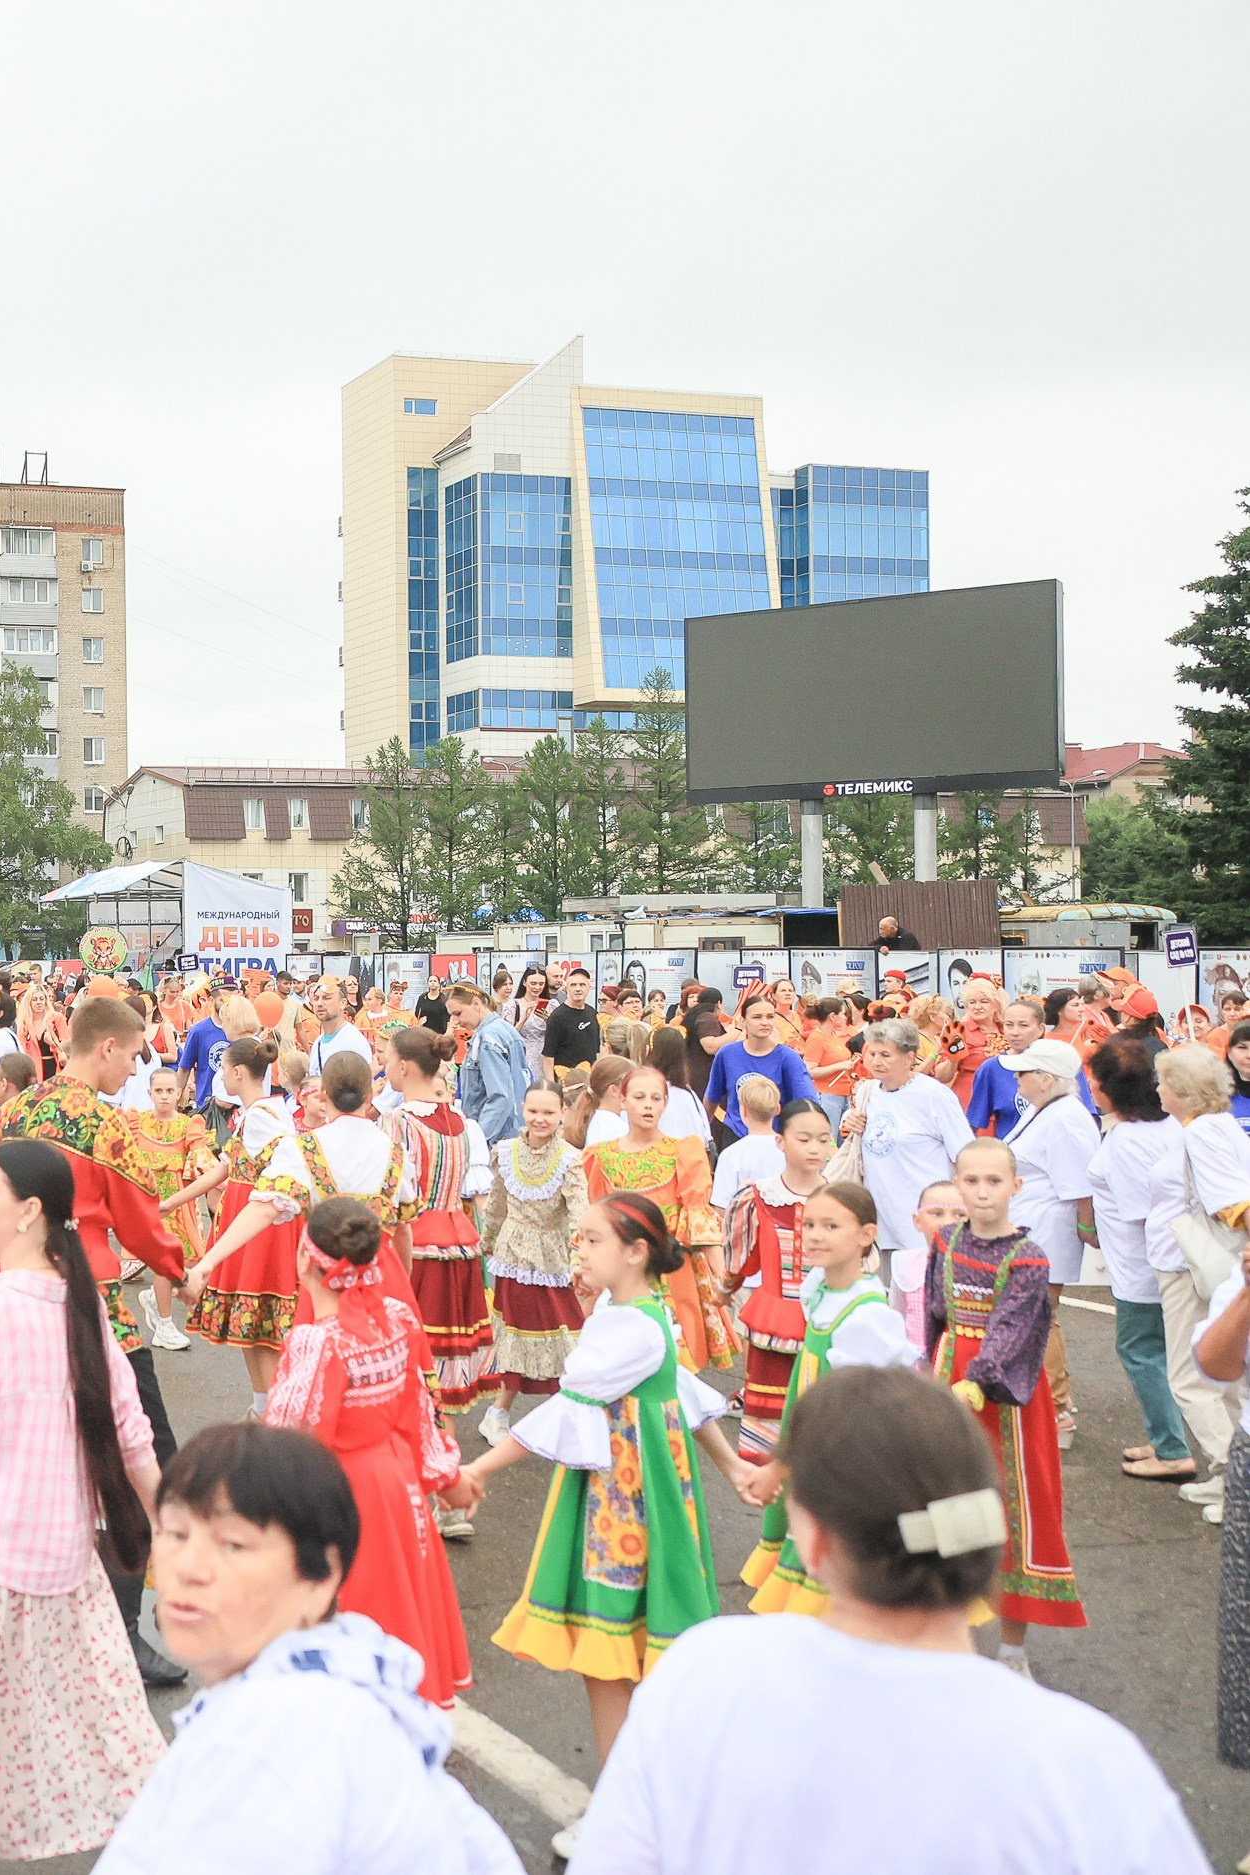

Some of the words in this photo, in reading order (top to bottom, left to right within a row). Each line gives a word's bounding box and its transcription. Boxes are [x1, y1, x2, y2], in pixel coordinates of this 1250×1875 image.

[835, 780, 913, 796] ТЕЛЕМИКС
[197, 910, 280, 920] МЕЖДУНАРОДНЫЙ
[199, 927, 280, 951] ДЕНЬ
[199, 958, 278, 978] ТИГРА
